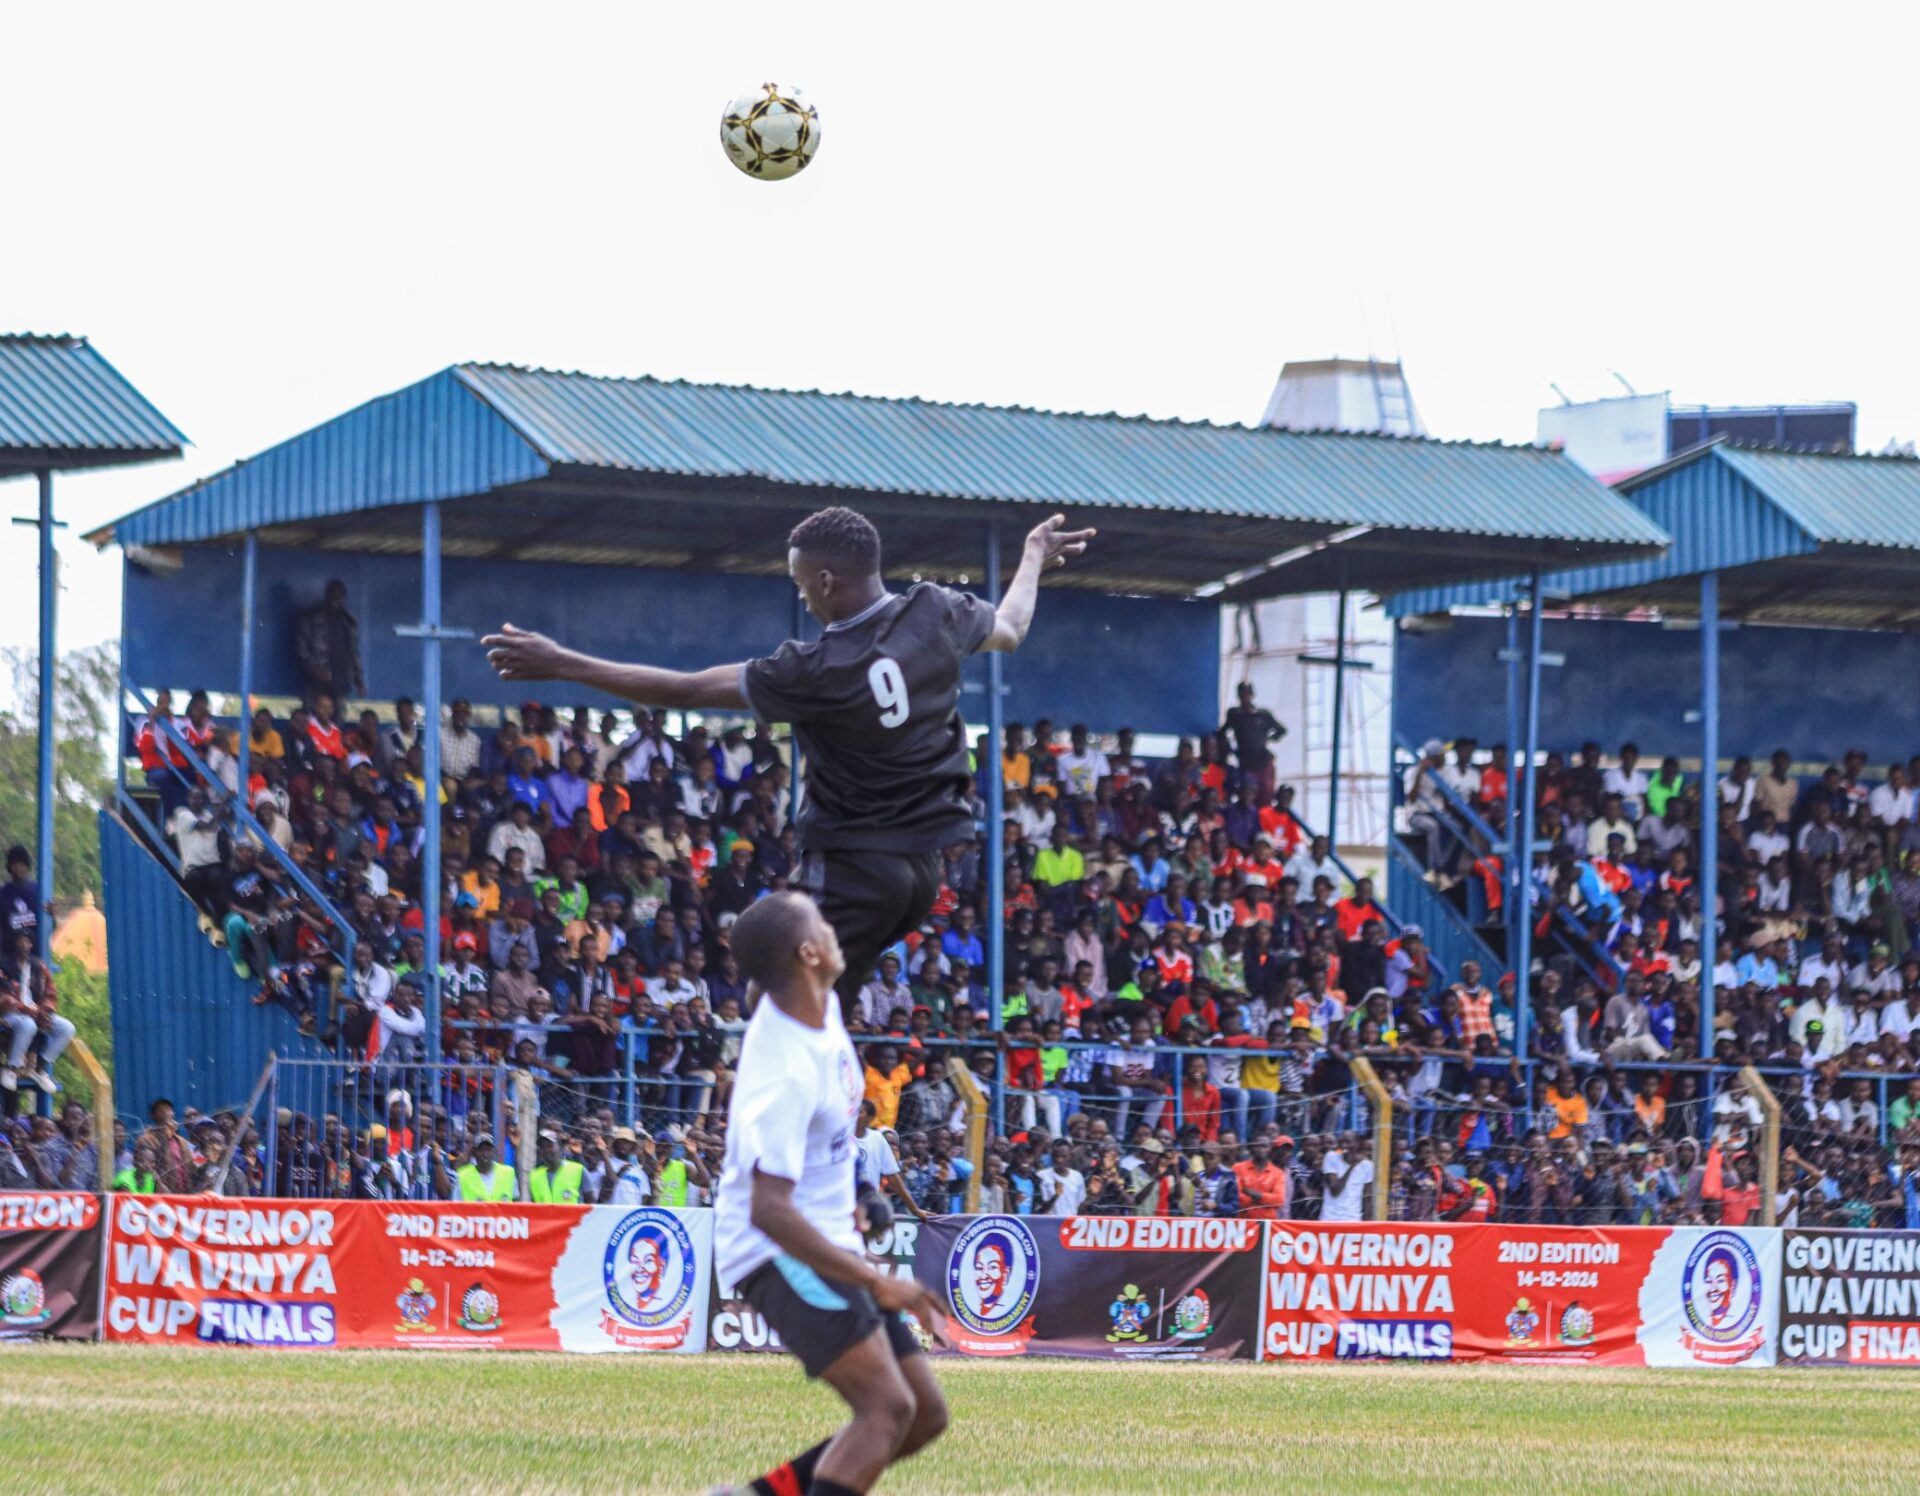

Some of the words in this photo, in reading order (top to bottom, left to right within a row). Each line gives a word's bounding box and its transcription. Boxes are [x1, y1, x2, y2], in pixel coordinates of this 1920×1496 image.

[867, 658, 909, 728] 9
[117, 1202, 335, 1246] GOVERNOR
[386, 1213, 434, 1238] 2ND
[437, 1214, 529, 1240] EDITION
[956, 1219, 995, 1253] GOVERNOR
[1023, 1238, 1035, 1257] CUP
[1069, 1218, 1129, 1248] 2ND
[1132, 1219, 1247, 1249] EDITION
[400, 1248, 496, 1268] 14-12-2024
[1270, 1231, 1454, 1267] GOVERNOR
[1498, 1241, 1539, 1263] 2ND
[1540, 1242, 1620, 1264] EDITION
[115, 1243, 337, 1294] WAVINYA
[1517, 1270, 1599, 1288] 14-12-2024
[1269, 1272, 1455, 1313] WAVINYA
[109, 1297, 196, 1335] CUP
[200, 1303, 334, 1343] FINALS
[1266, 1322, 1334, 1356] CUP
[1337, 1323, 1451, 1358] FINALS
[1782, 1324, 1847, 1358] CUP
